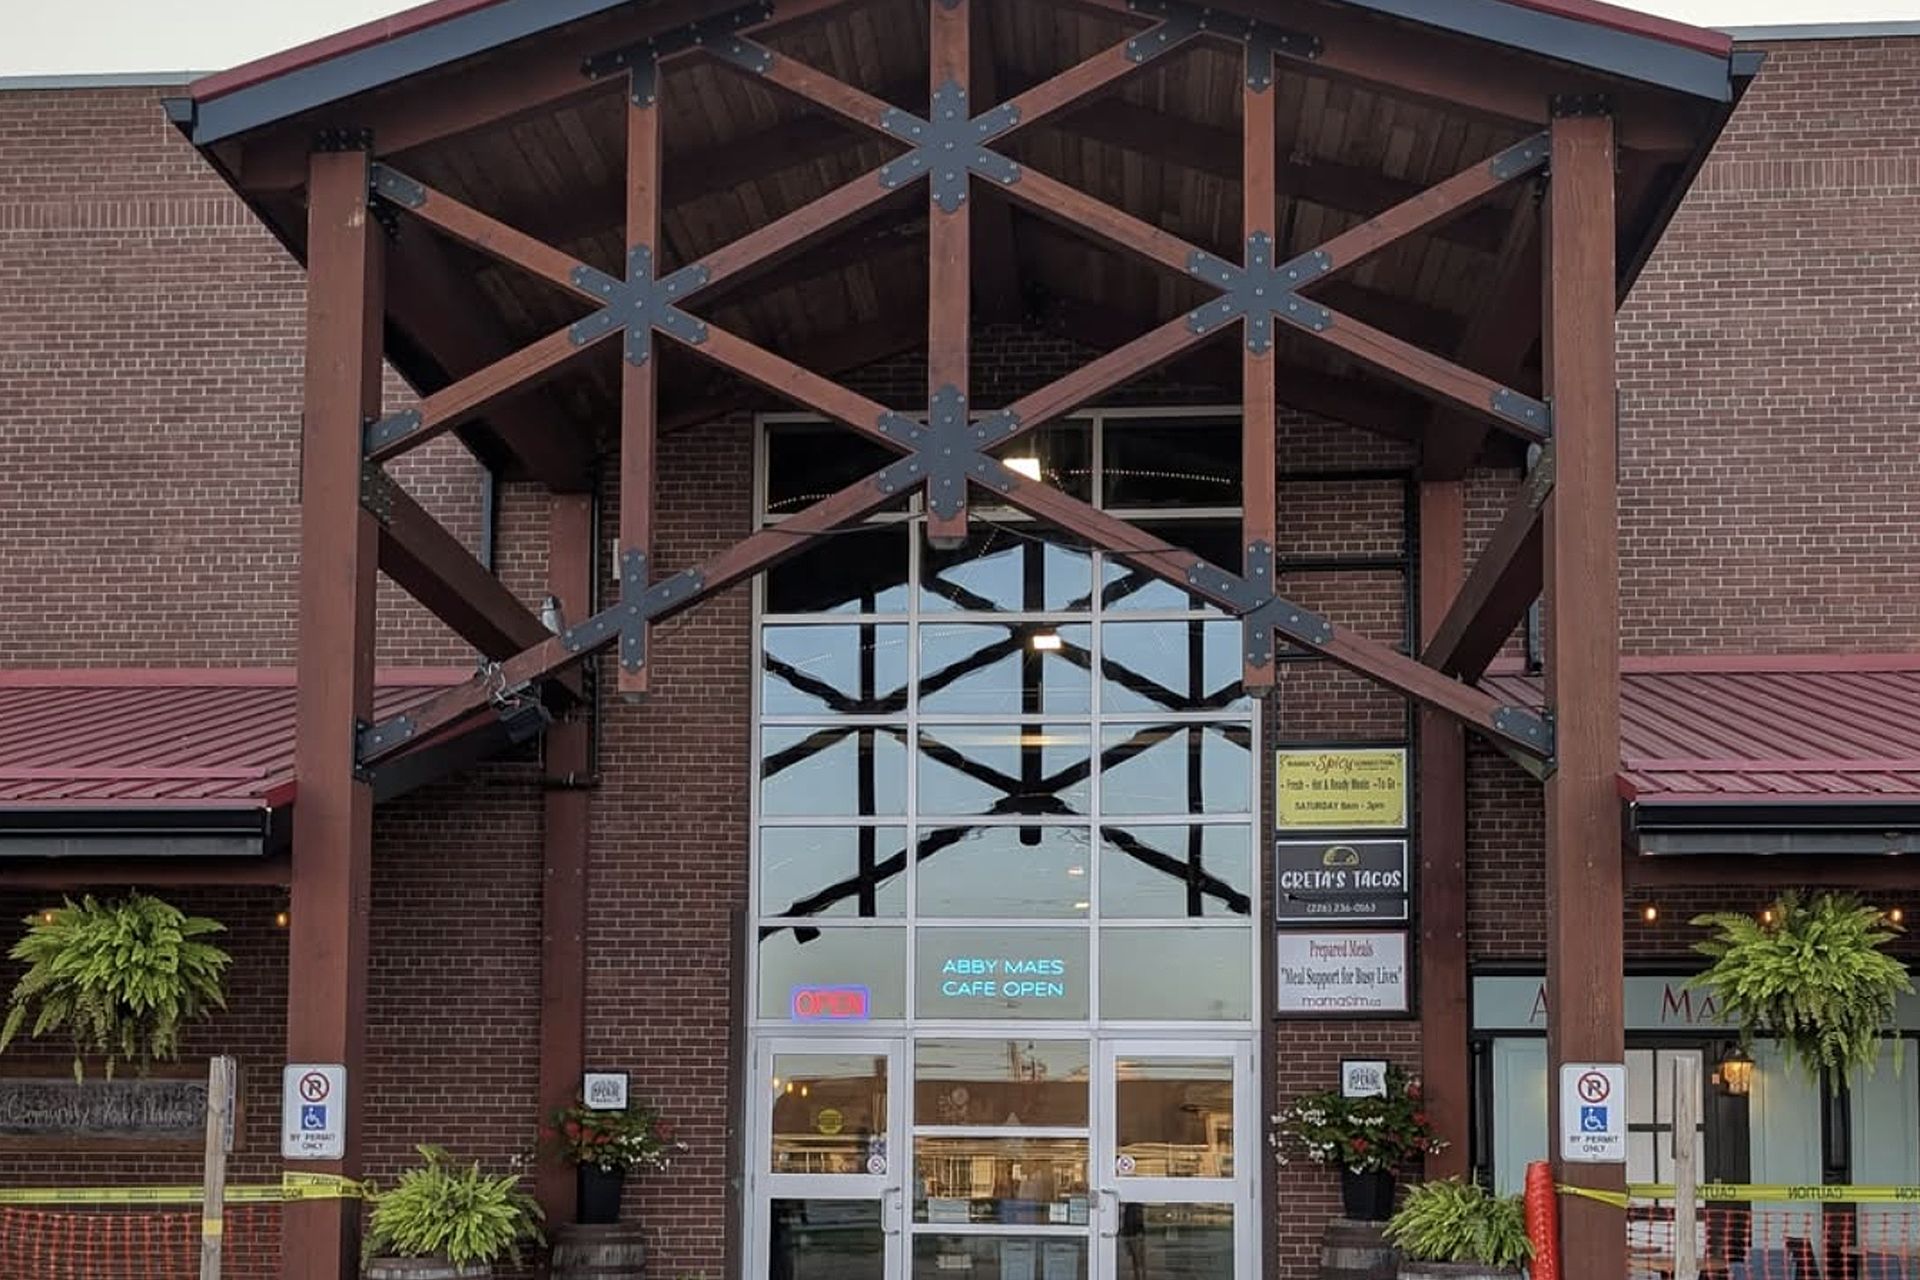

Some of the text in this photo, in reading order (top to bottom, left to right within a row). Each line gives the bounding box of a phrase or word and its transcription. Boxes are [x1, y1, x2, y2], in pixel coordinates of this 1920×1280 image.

[1315, 754, 1354, 774] Spicy
[1295, 802, 1339, 811] SATURDAY
[1353, 869, 1402, 888] TACOS
[1309, 939, 1374, 962] Prepared Meals
[942, 959, 1065, 975] ABBY MAES
[1306, 967, 1340, 990] Support
[1341, 966, 1354, 985] for
[1355, 967, 1375, 990] Busy
[942, 980, 1064, 997] CAFE OPEN
[795, 991, 863, 1017] OPEN
[305, 1132, 336, 1142] PERMIT
[1586, 1135, 1619, 1144] PERMIT
[302, 1142, 323, 1150] ONLY
[1583, 1144, 1606, 1153] ONLY
